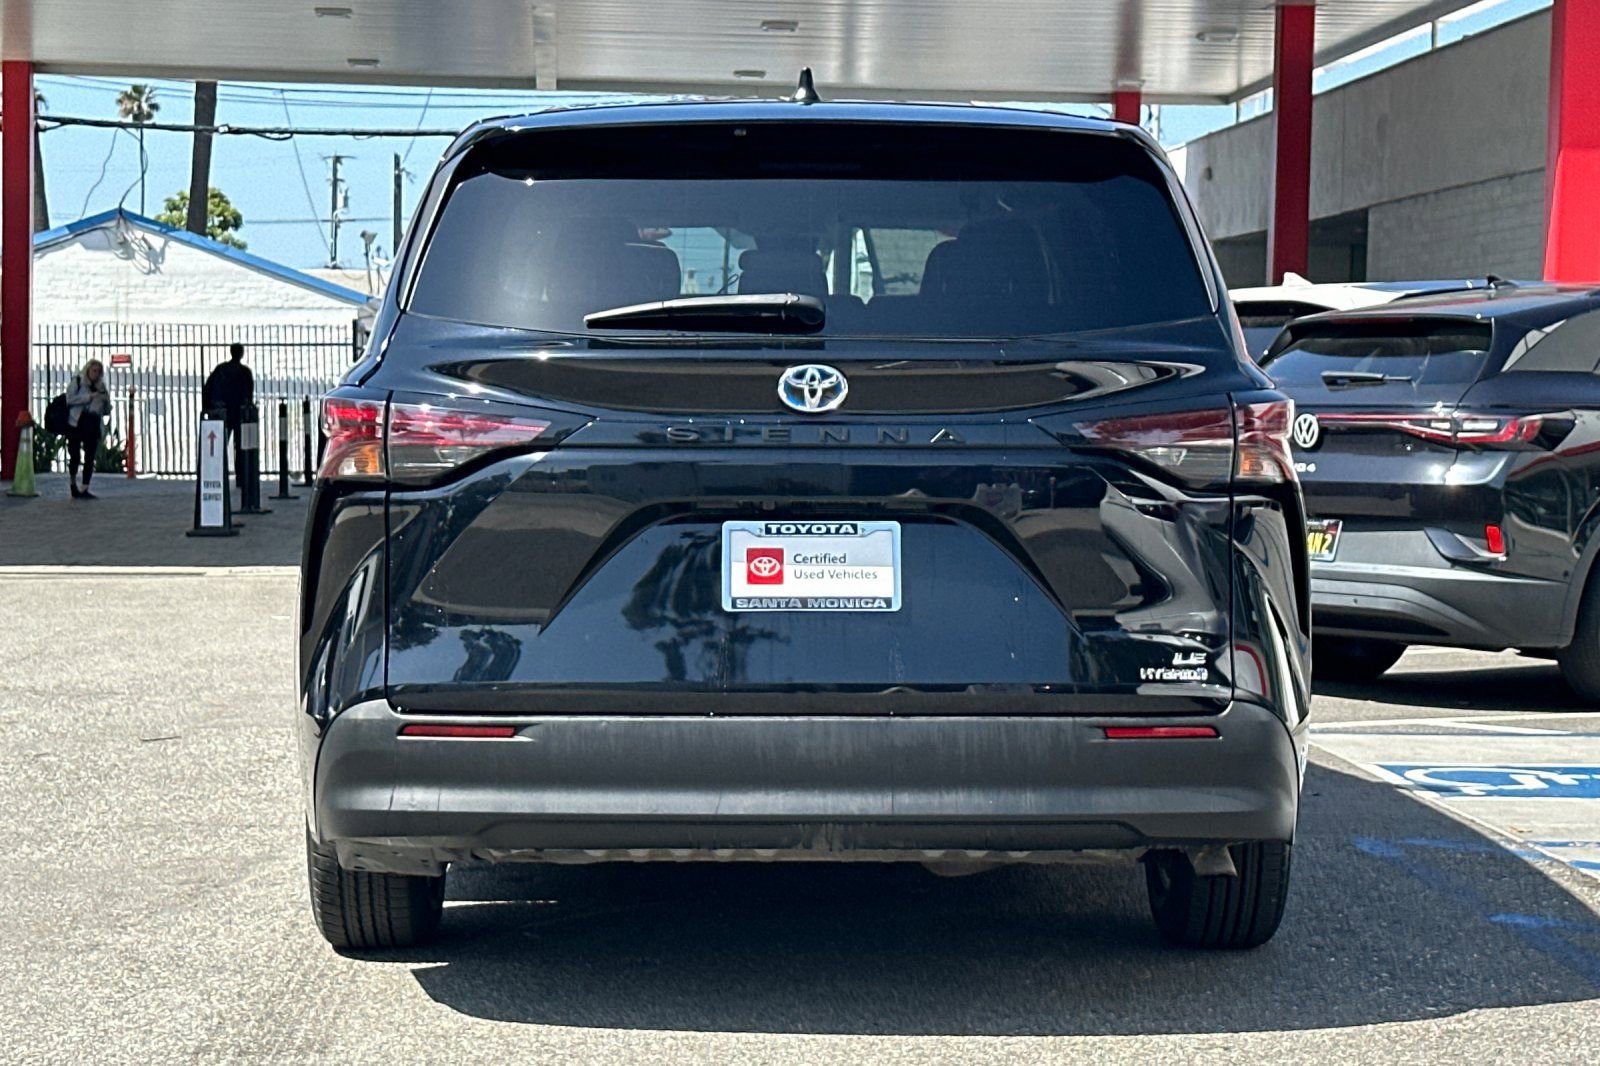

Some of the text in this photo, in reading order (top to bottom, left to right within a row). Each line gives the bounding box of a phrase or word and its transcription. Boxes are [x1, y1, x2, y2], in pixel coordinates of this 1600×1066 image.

[666, 426, 966, 443] SIENNA
[767, 524, 855, 534] TOYOTA
[793, 553, 847, 564] Certified
[793, 569, 878, 580] Used Vehicles
[736, 598, 887, 609] SANTA MONICA
